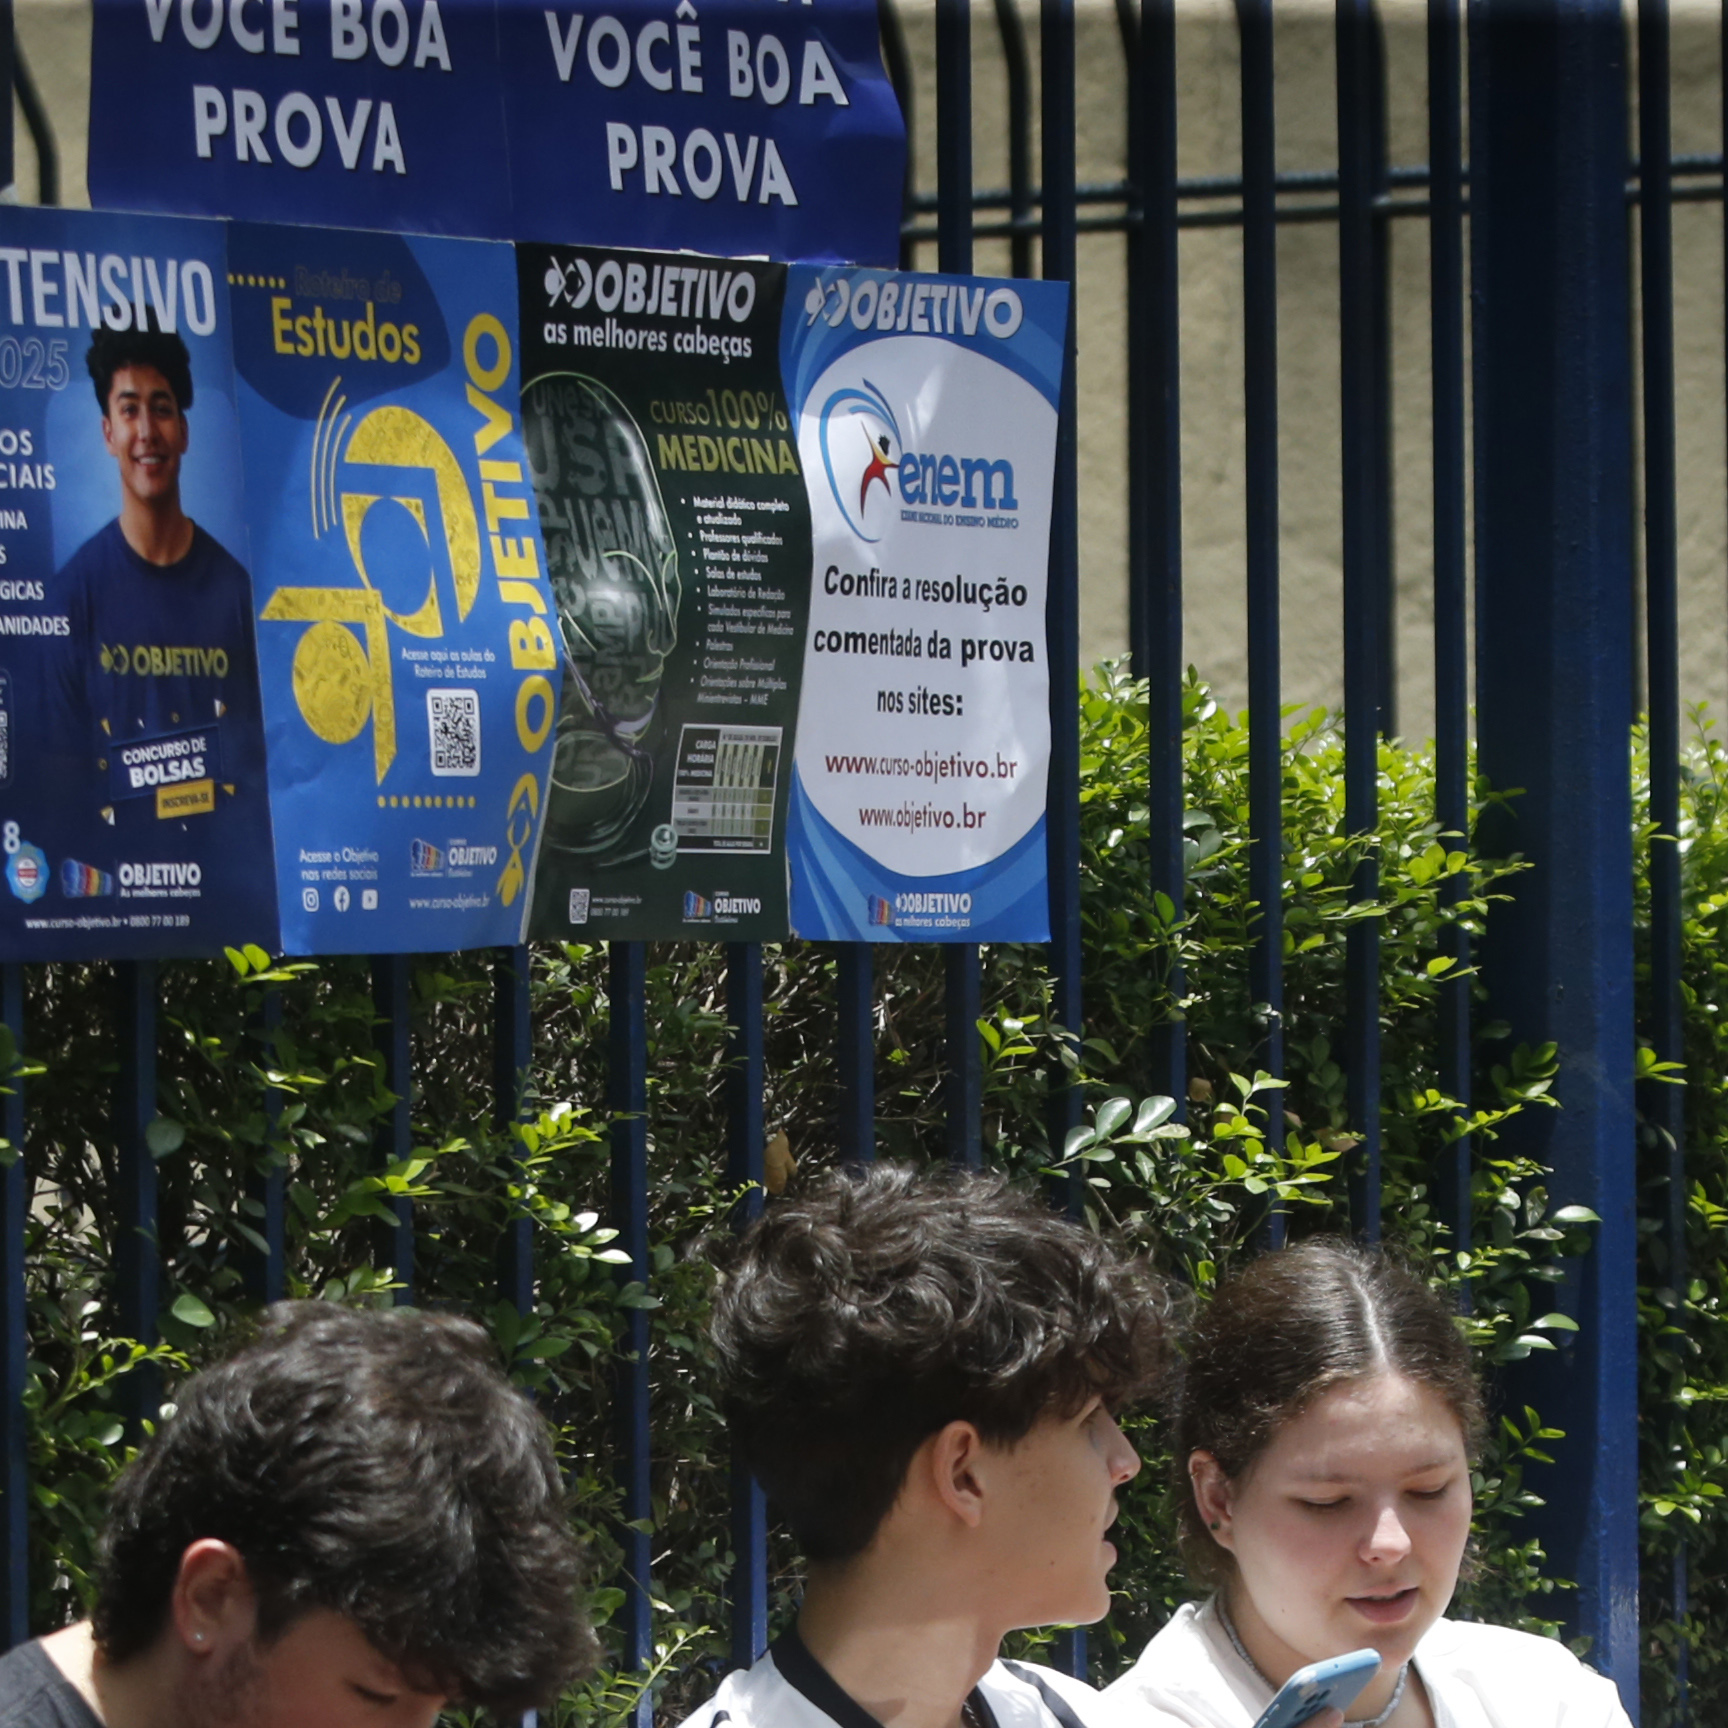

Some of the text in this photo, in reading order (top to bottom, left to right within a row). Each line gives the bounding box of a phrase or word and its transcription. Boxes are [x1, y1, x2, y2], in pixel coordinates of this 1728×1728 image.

[330, 0, 453, 72] BOA
[544, 0, 850, 107] VOCÊ BOA
[192, 85, 407, 174] PROVA
[605, 121, 798, 207] PROVA
[373, 269, 403, 304] de
[594, 259, 756, 323] OBJETIVO
[849, 279, 1024, 339] OBJETIVO
[271, 296, 422, 366] Estudos
[544, 317, 753, 364] as melhores cabeças
[650, 400, 710, 426] CURSO
[708, 388, 788, 432] 100%
[656, 433, 800, 476] MEDICINA
[898, 452, 1019, 511] enem
[693, 495, 790, 514] Material didático completo
[943, 514, 955, 525] DO
[462, 312, 557, 754] OBJETIVO
[699, 529, 740, 544] Professores
[731, 548, 741, 562] de
[747, 585, 756, 599] de
[824, 565, 1028, 612] Confira a resolução
[757, 621, 766, 635] de
[132, 645, 230, 679] OBJETIVO
[813, 628, 1035, 667] comentada da prova
[414, 663, 487, 679] Roteiro de Estudos
[877, 685, 964, 716] nos sites:
[122, 736, 208, 765] CONCURSO DE
[128, 756, 207, 789] BOLSAS
[825, 751, 1018, 784] www.curso-objetivo.br
[859, 801, 987, 834] www.objetivo.br
[3, 820, 22, 855] 8
[299, 848, 333, 864] Acesse
[342, 847, 379, 866] Objetivo
[448, 846, 498, 866] OBJETIVO
[119, 862, 203, 887] OBJETIVO
[300, 866, 378, 882] nas redes sociais
[714, 897, 762, 914] OBJETIVO
[905, 892, 972, 914] OBJETIVO
